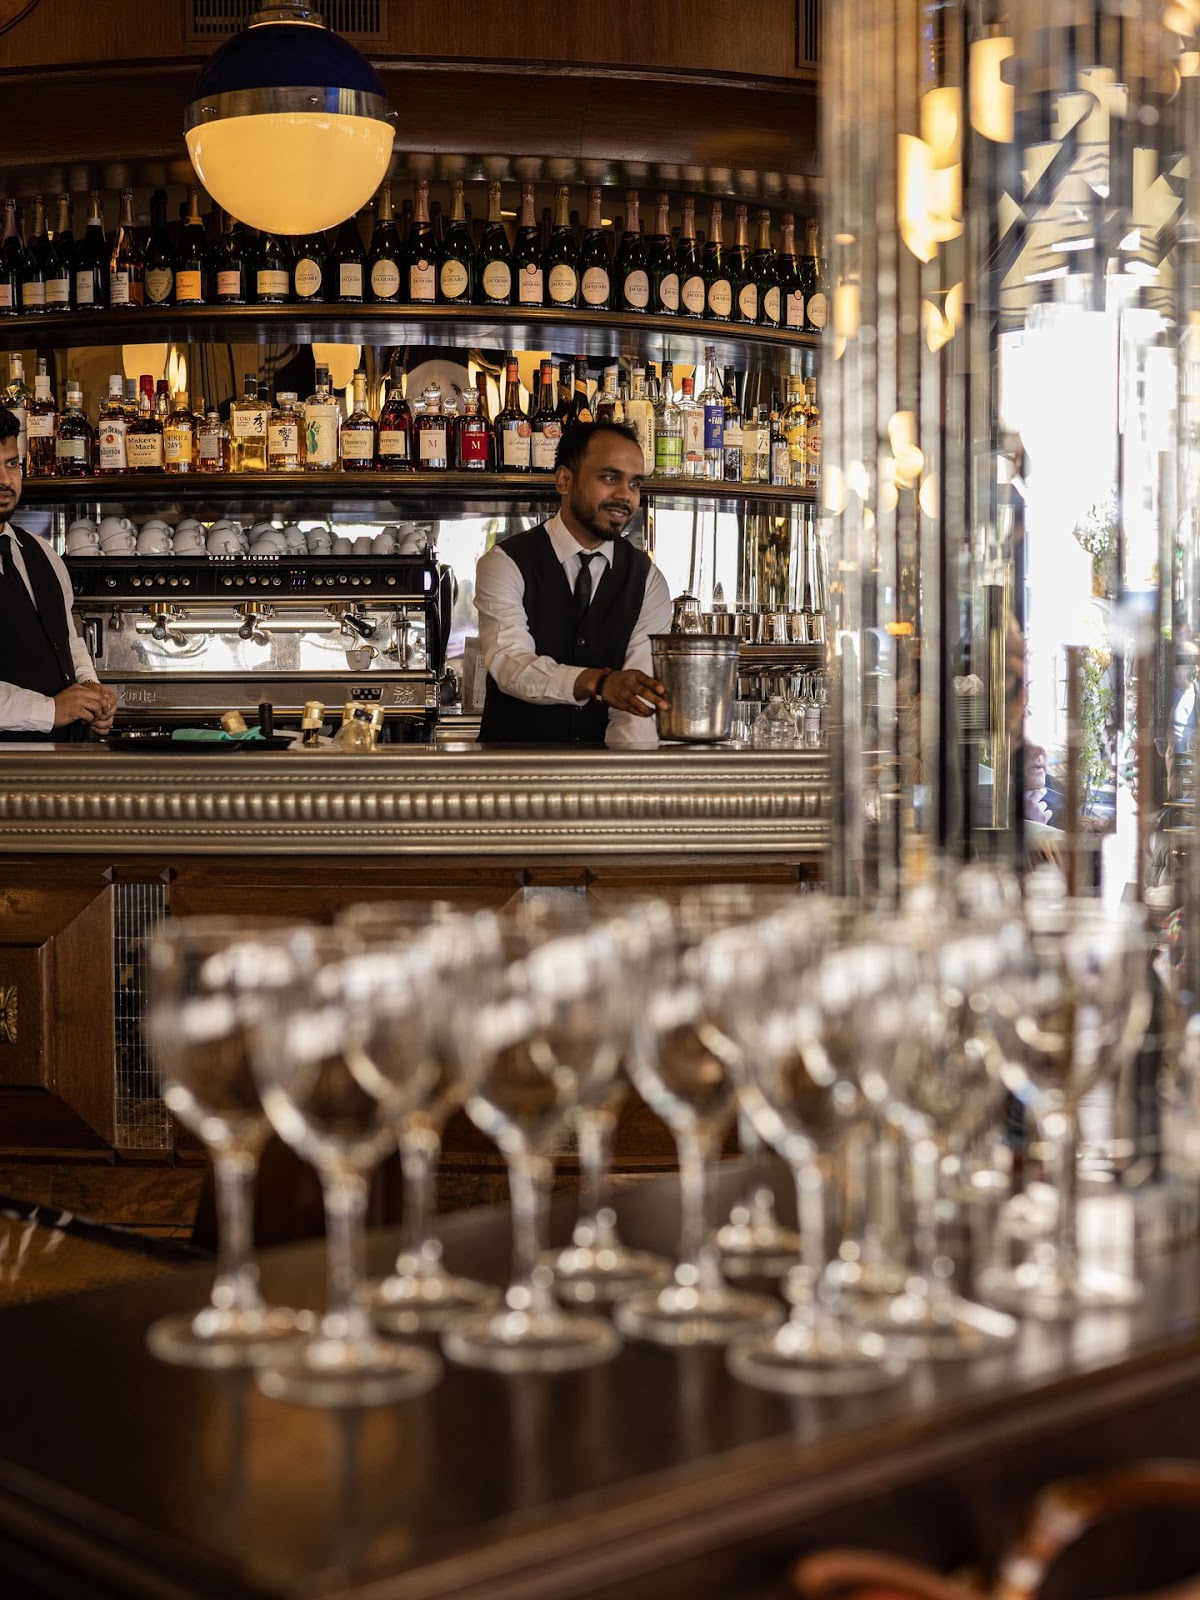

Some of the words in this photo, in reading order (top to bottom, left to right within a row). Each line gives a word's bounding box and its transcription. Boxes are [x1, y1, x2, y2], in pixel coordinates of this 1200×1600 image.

[711, 416, 723, 425] FAIR
[428, 439, 437, 448] M
[471, 440, 481, 450] M
